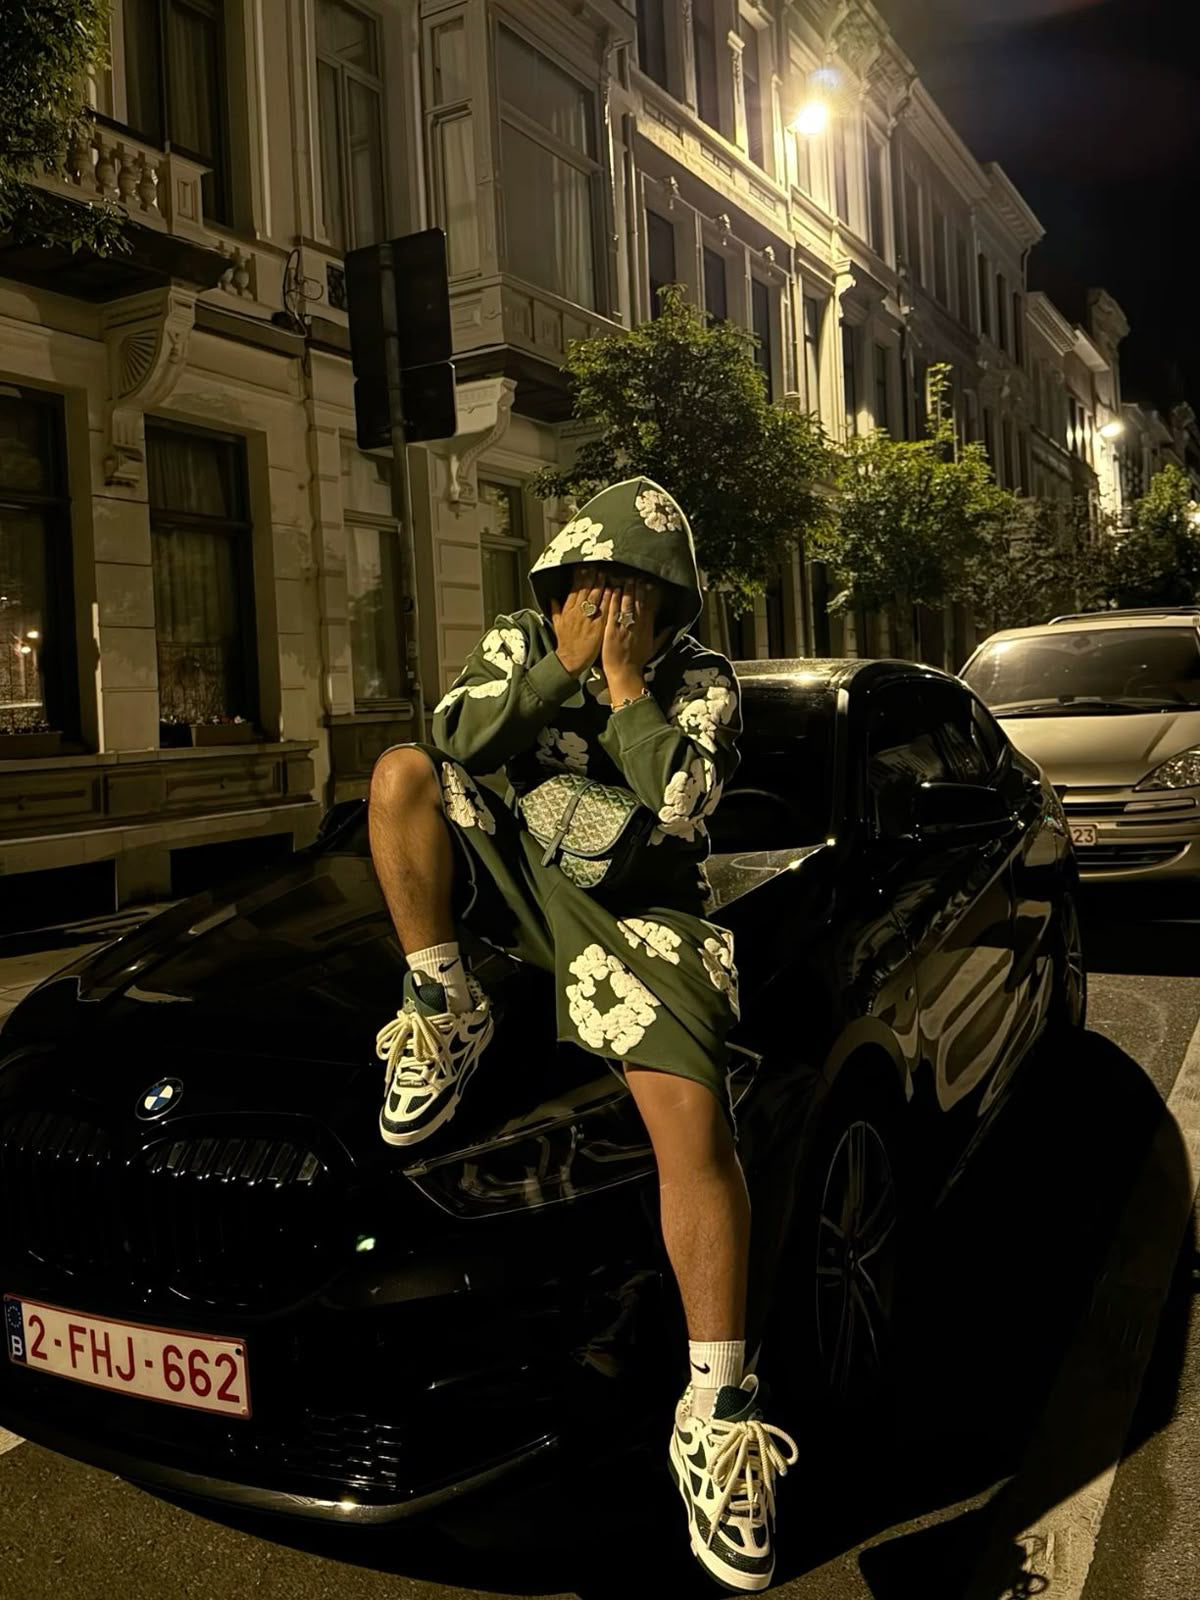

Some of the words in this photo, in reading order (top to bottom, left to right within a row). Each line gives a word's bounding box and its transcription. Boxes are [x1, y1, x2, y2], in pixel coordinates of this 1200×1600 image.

[1073, 829, 1094, 843] 23
[11, 1335, 23, 1356] B
[28, 1314, 240, 1403] 2-FHJ-662
